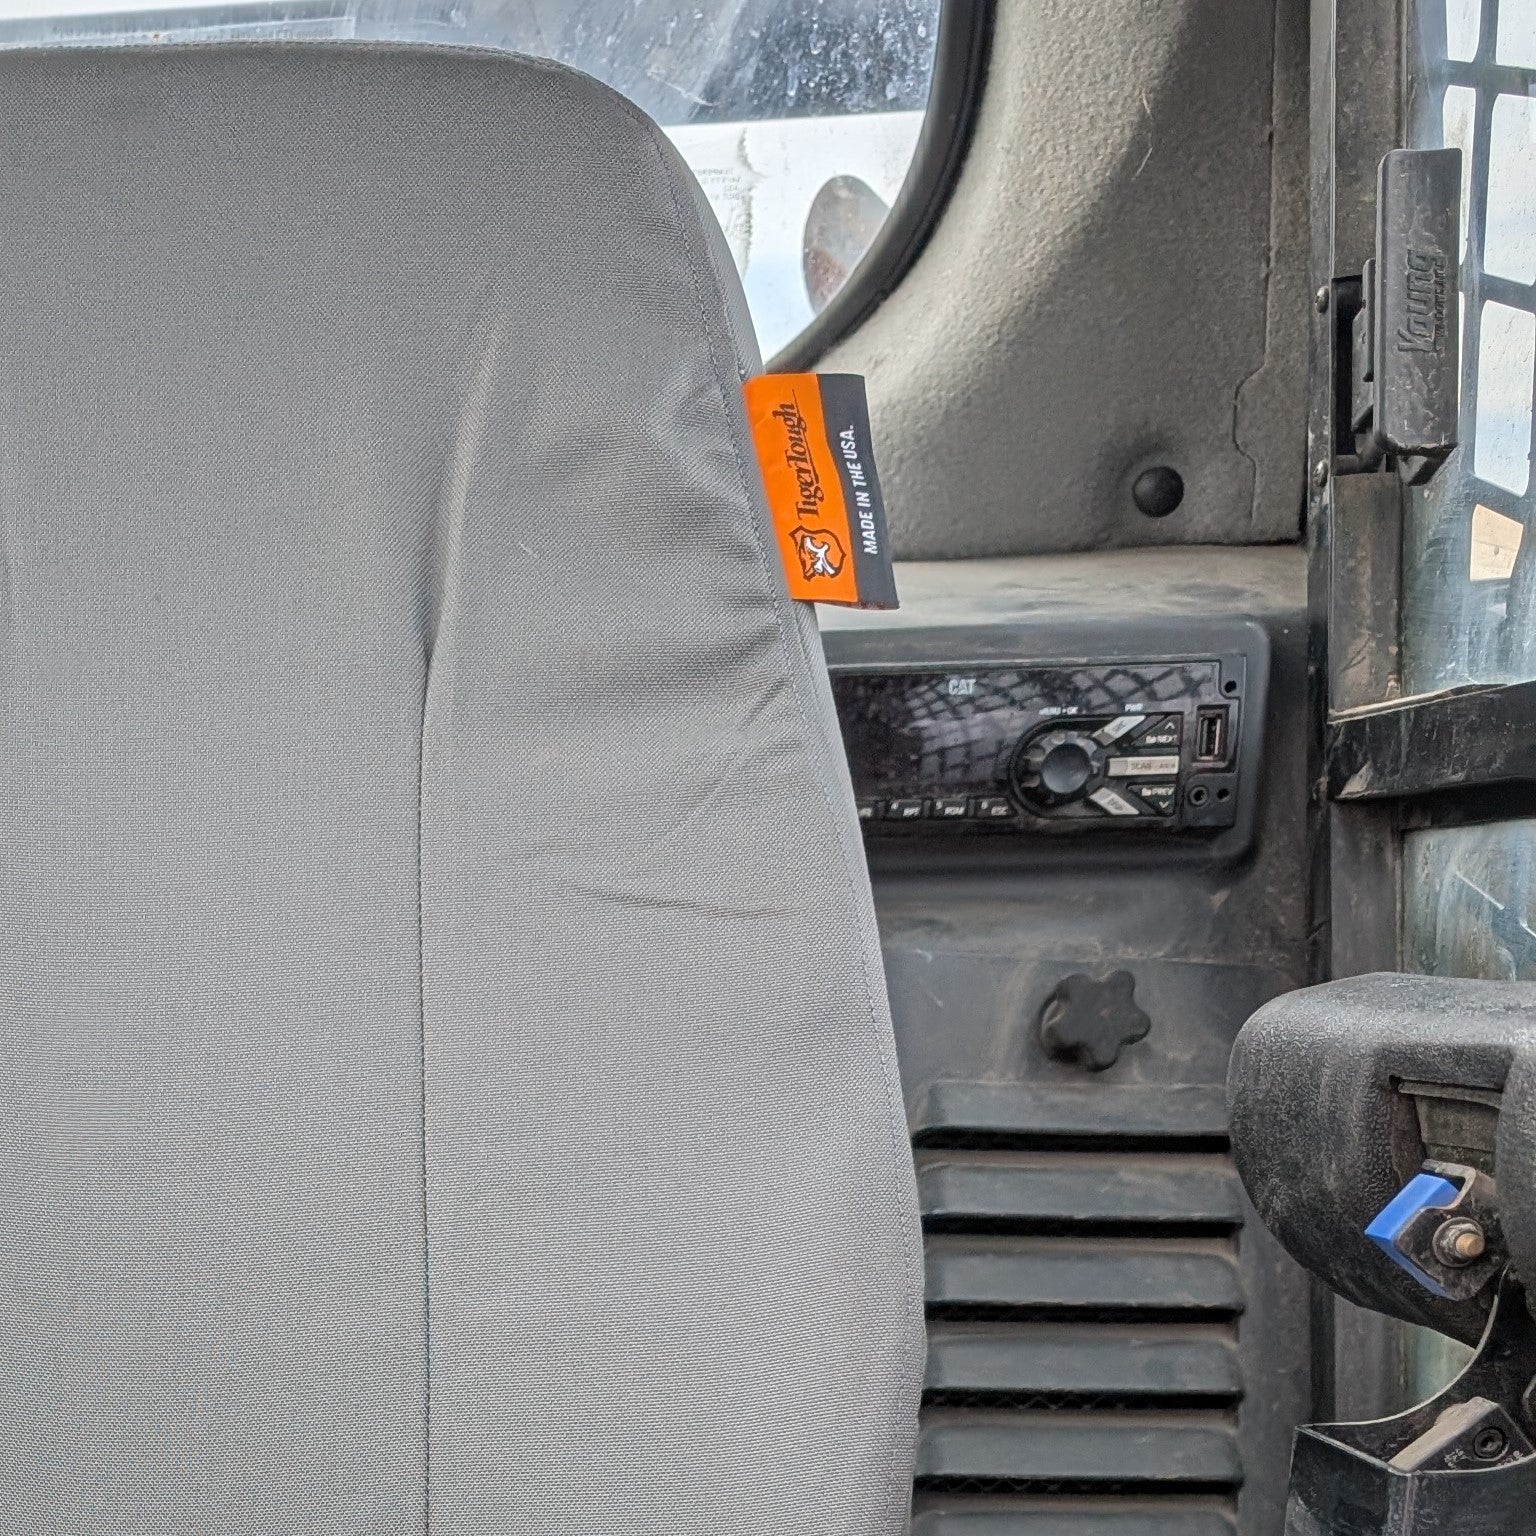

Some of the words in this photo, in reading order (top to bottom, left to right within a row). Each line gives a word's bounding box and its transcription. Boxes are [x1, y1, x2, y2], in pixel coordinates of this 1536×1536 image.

[1397, 249, 1441, 352] Young
[772, 390, 824, 520] TigerTough
[839, 424, 859, 460] USA.
[847, 461, 866, 488] THE
[855, 491, 871, 508] IN
[859, 512, 878, 555] MADE
[949, 678, 976, 695] CAT
